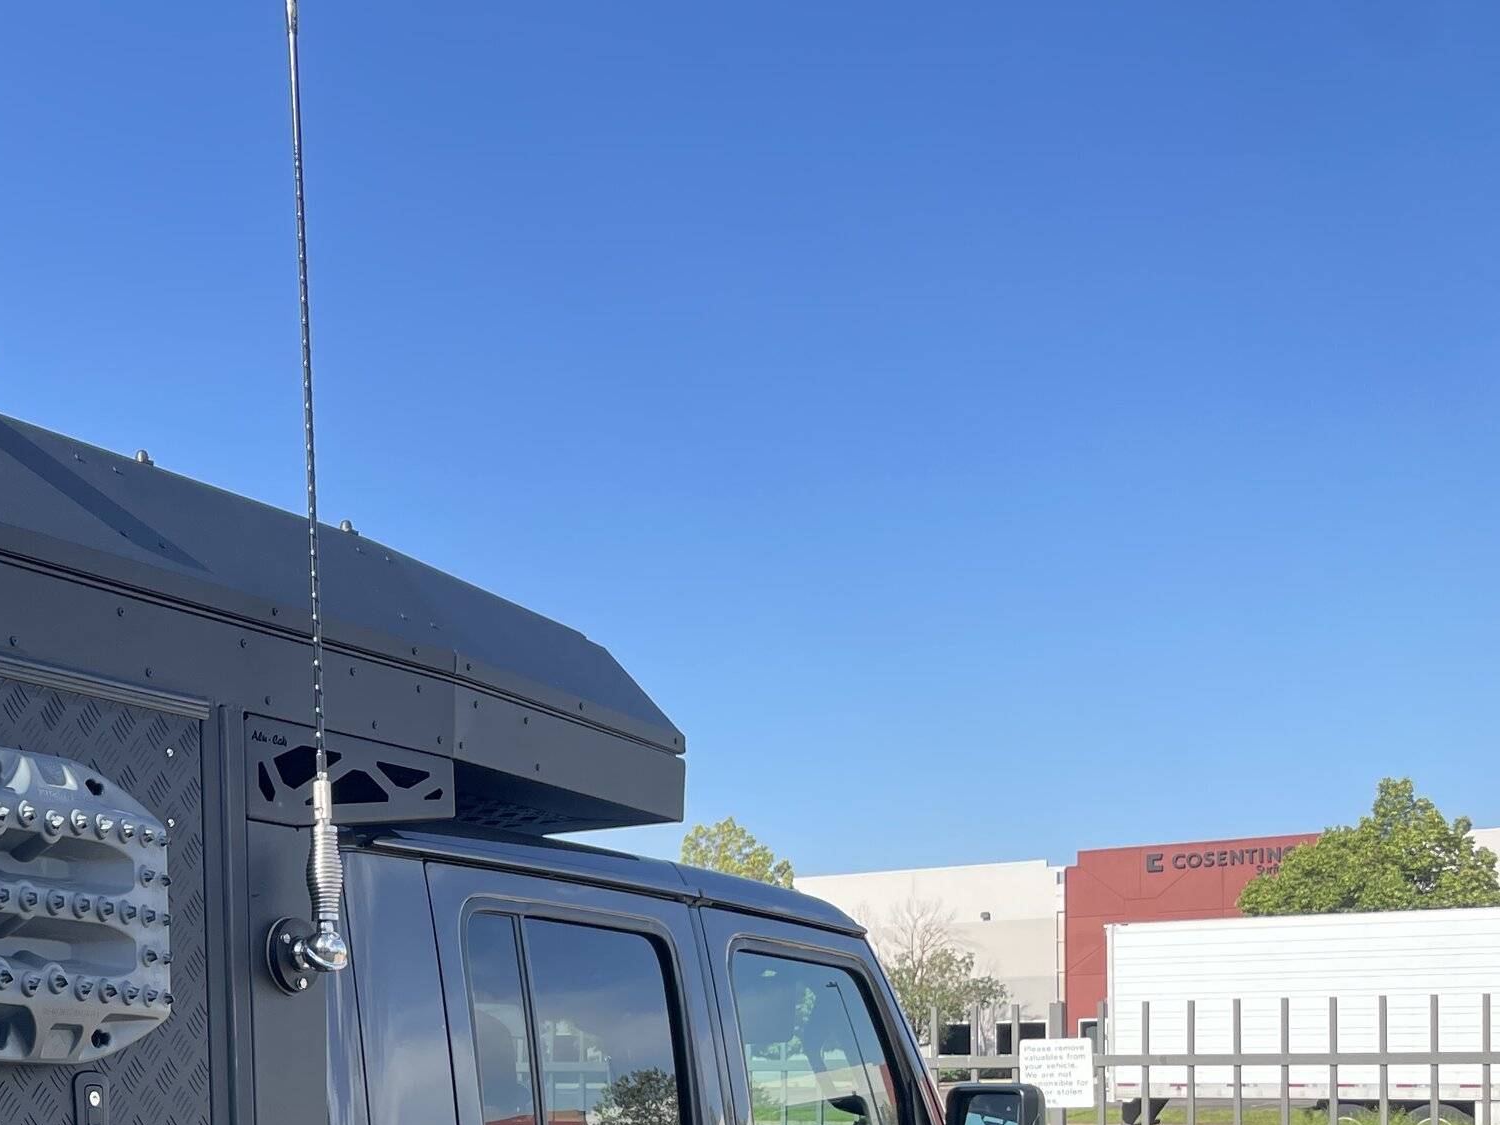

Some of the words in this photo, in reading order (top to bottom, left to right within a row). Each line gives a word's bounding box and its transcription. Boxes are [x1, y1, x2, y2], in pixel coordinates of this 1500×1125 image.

[251, 729, 288, 747] Alu-Cab
[1023, 1044, 1051, 1052] Please
[1054, 1044, 1085, 1052] remove
[1024, 1053, 1064, 1061] valuables
[1024, 1063, 1043, 1071] your
[1025, 1071, 1038, 1079] We
[1076, 1079, 1089, 1087] for
[1056, 1088, 1083, 1096] stolen
